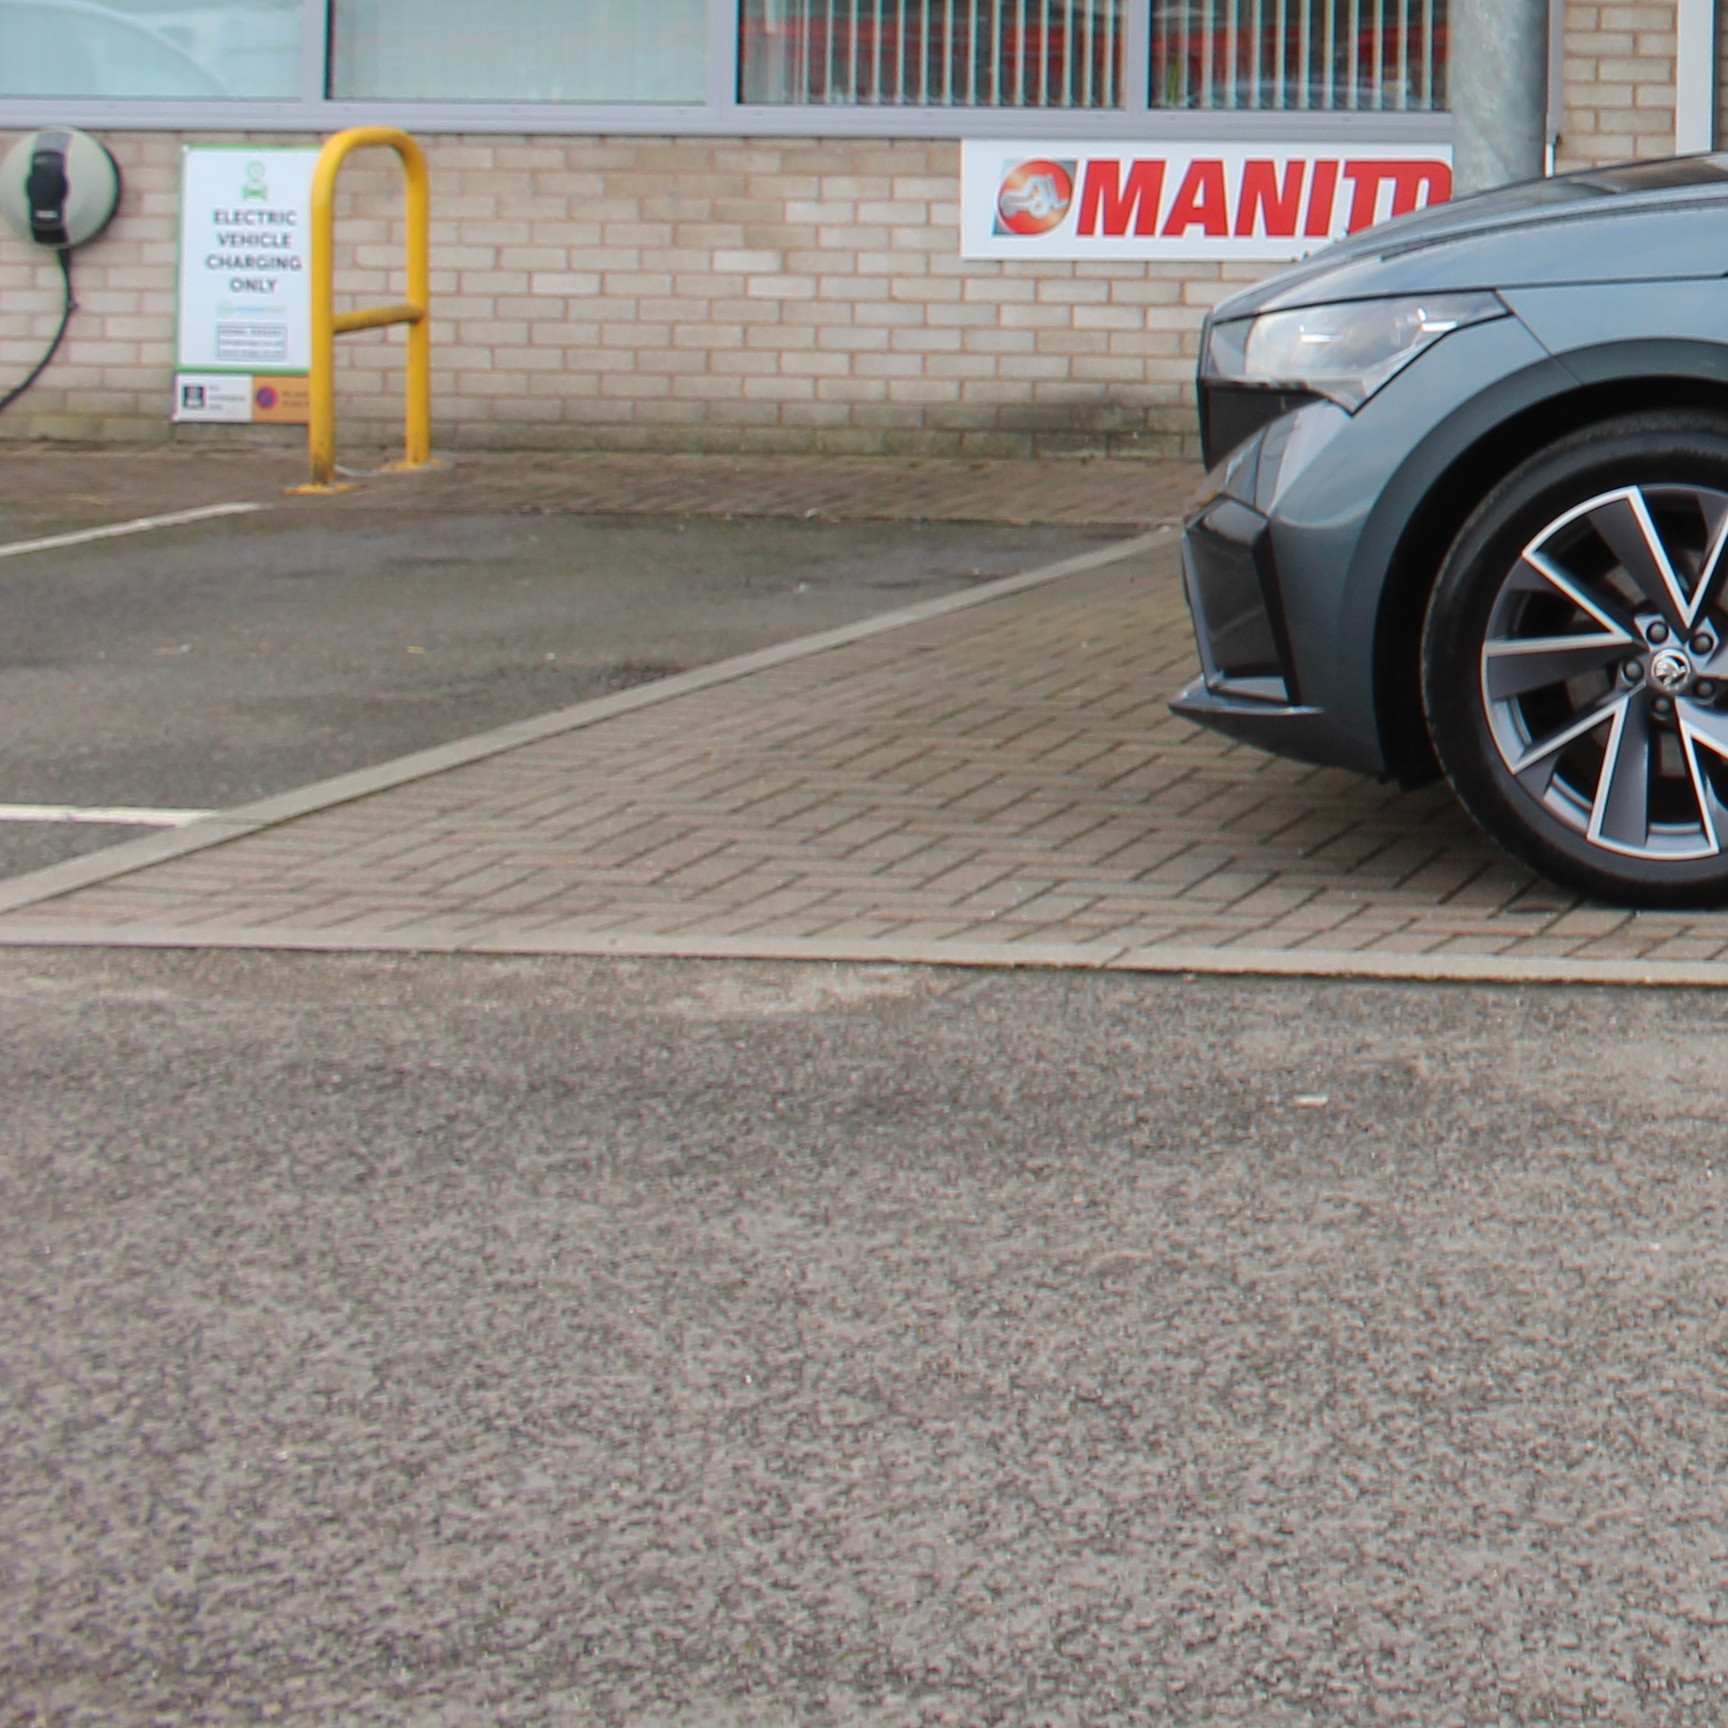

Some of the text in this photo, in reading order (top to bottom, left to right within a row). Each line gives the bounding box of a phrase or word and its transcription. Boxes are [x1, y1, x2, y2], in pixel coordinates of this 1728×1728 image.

[213, 209, 298, 225] ELECTRIC
[216, 232, 292, 247] VEHICLE
[205, 253, 303, 270] CHARGING
[228, 277, 279, 293] ONLY
